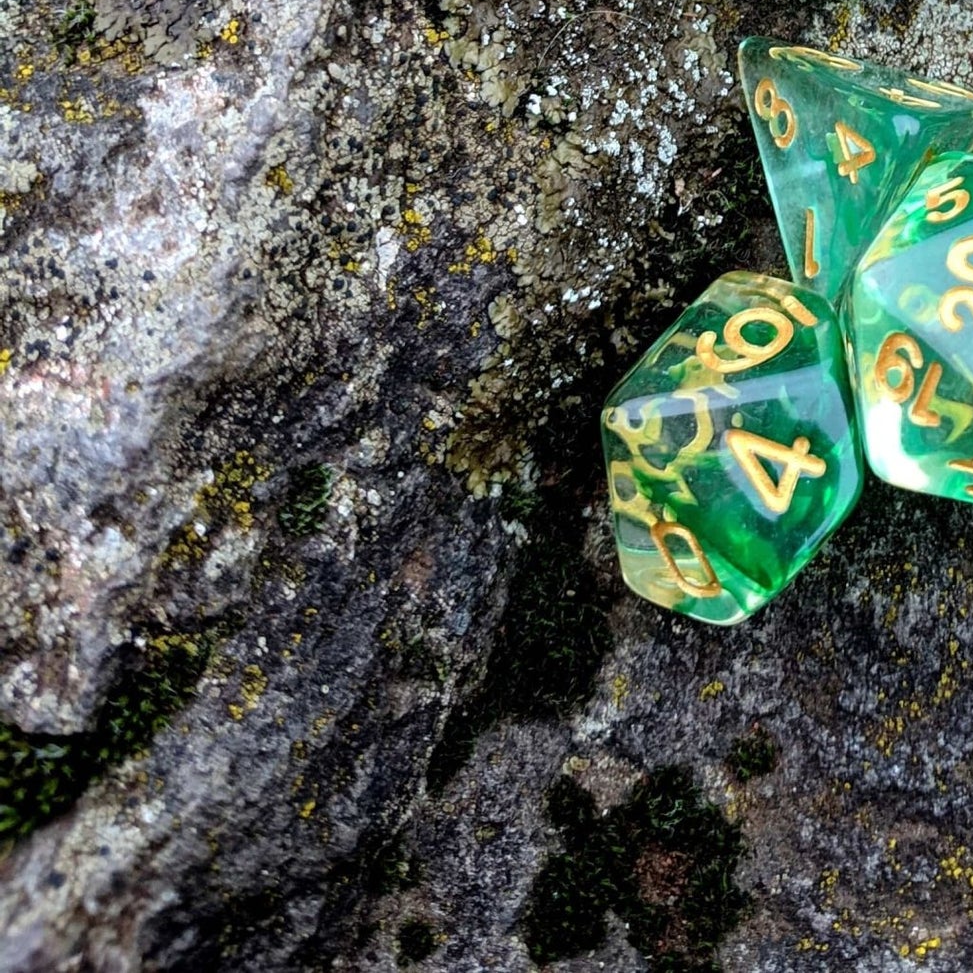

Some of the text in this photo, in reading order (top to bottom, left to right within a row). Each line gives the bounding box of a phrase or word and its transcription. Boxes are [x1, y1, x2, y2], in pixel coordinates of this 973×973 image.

[834, 121, 876, 184] 4
[925, 176, 971, 223] 5
[724, 428, 828, 514] 4
[651, 521, 722, 598] 0
